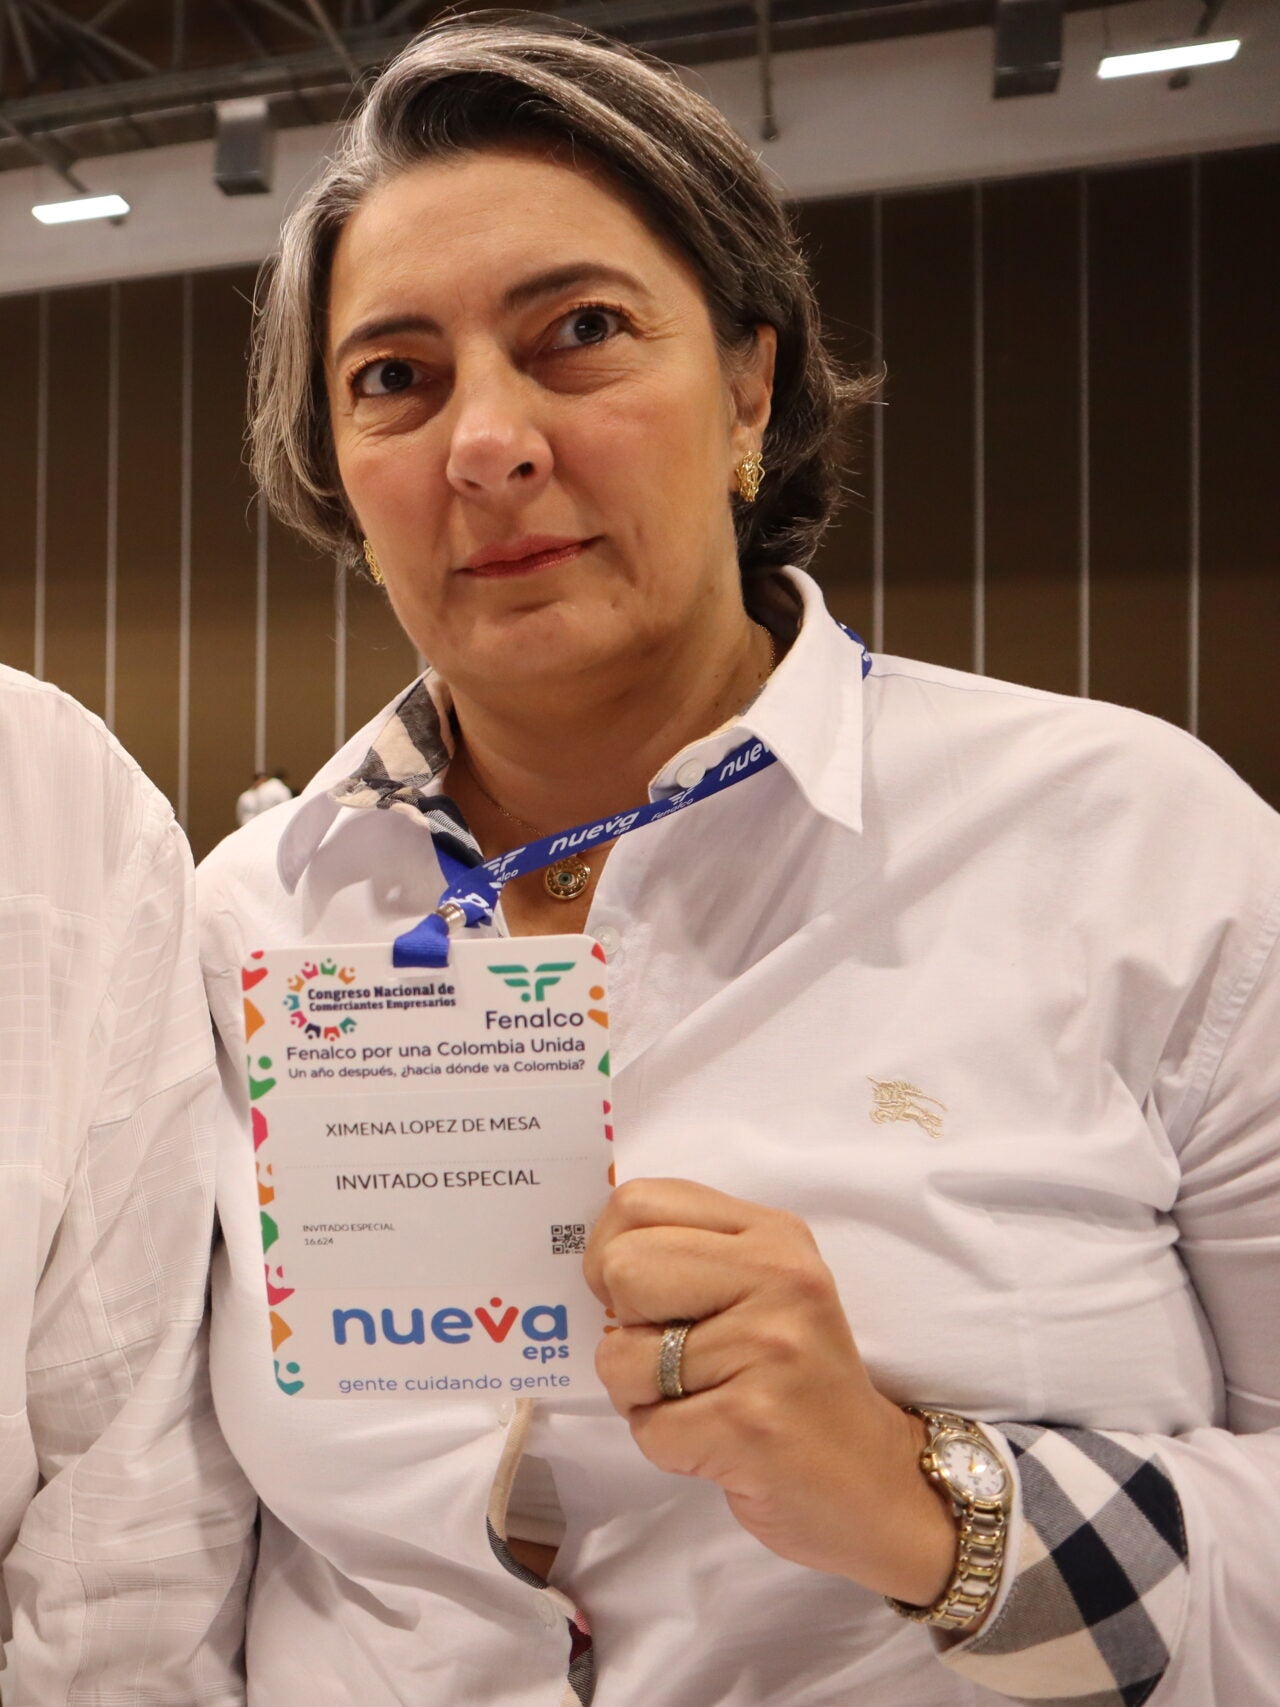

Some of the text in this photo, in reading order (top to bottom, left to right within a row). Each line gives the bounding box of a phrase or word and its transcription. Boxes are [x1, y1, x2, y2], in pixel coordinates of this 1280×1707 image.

[719, 742, 770, 782] nue
[650, 797, 695, 822] Fenalco
[548, 810, 641, 856] nueva
[308, 983, 455, 1002] Congreso Nacional de
[309, 997, 456, 1012] Comerciantes Empresarios
[485, 1007, 584, 1030] Fenalco
[286, 1036, 586, 1062] Fenalco por una Colombia Unida
[288, 1058, 586, 1080] Un año después, ¿hacia dónde va Colombia?
[325, 1115, 541, 1137] XIMENA LOPEZ DE MESA
[336, 1168, 541, 1191] INVITADO ESPECIAL
[302, 1222, 396, 1232] INVITADO ESPECIAL
[332, 1297, 568, 1346] nueva
[522, 1342, 570, 1365] eps
[338, 1373, 570, 1393] gente cuidando gente
